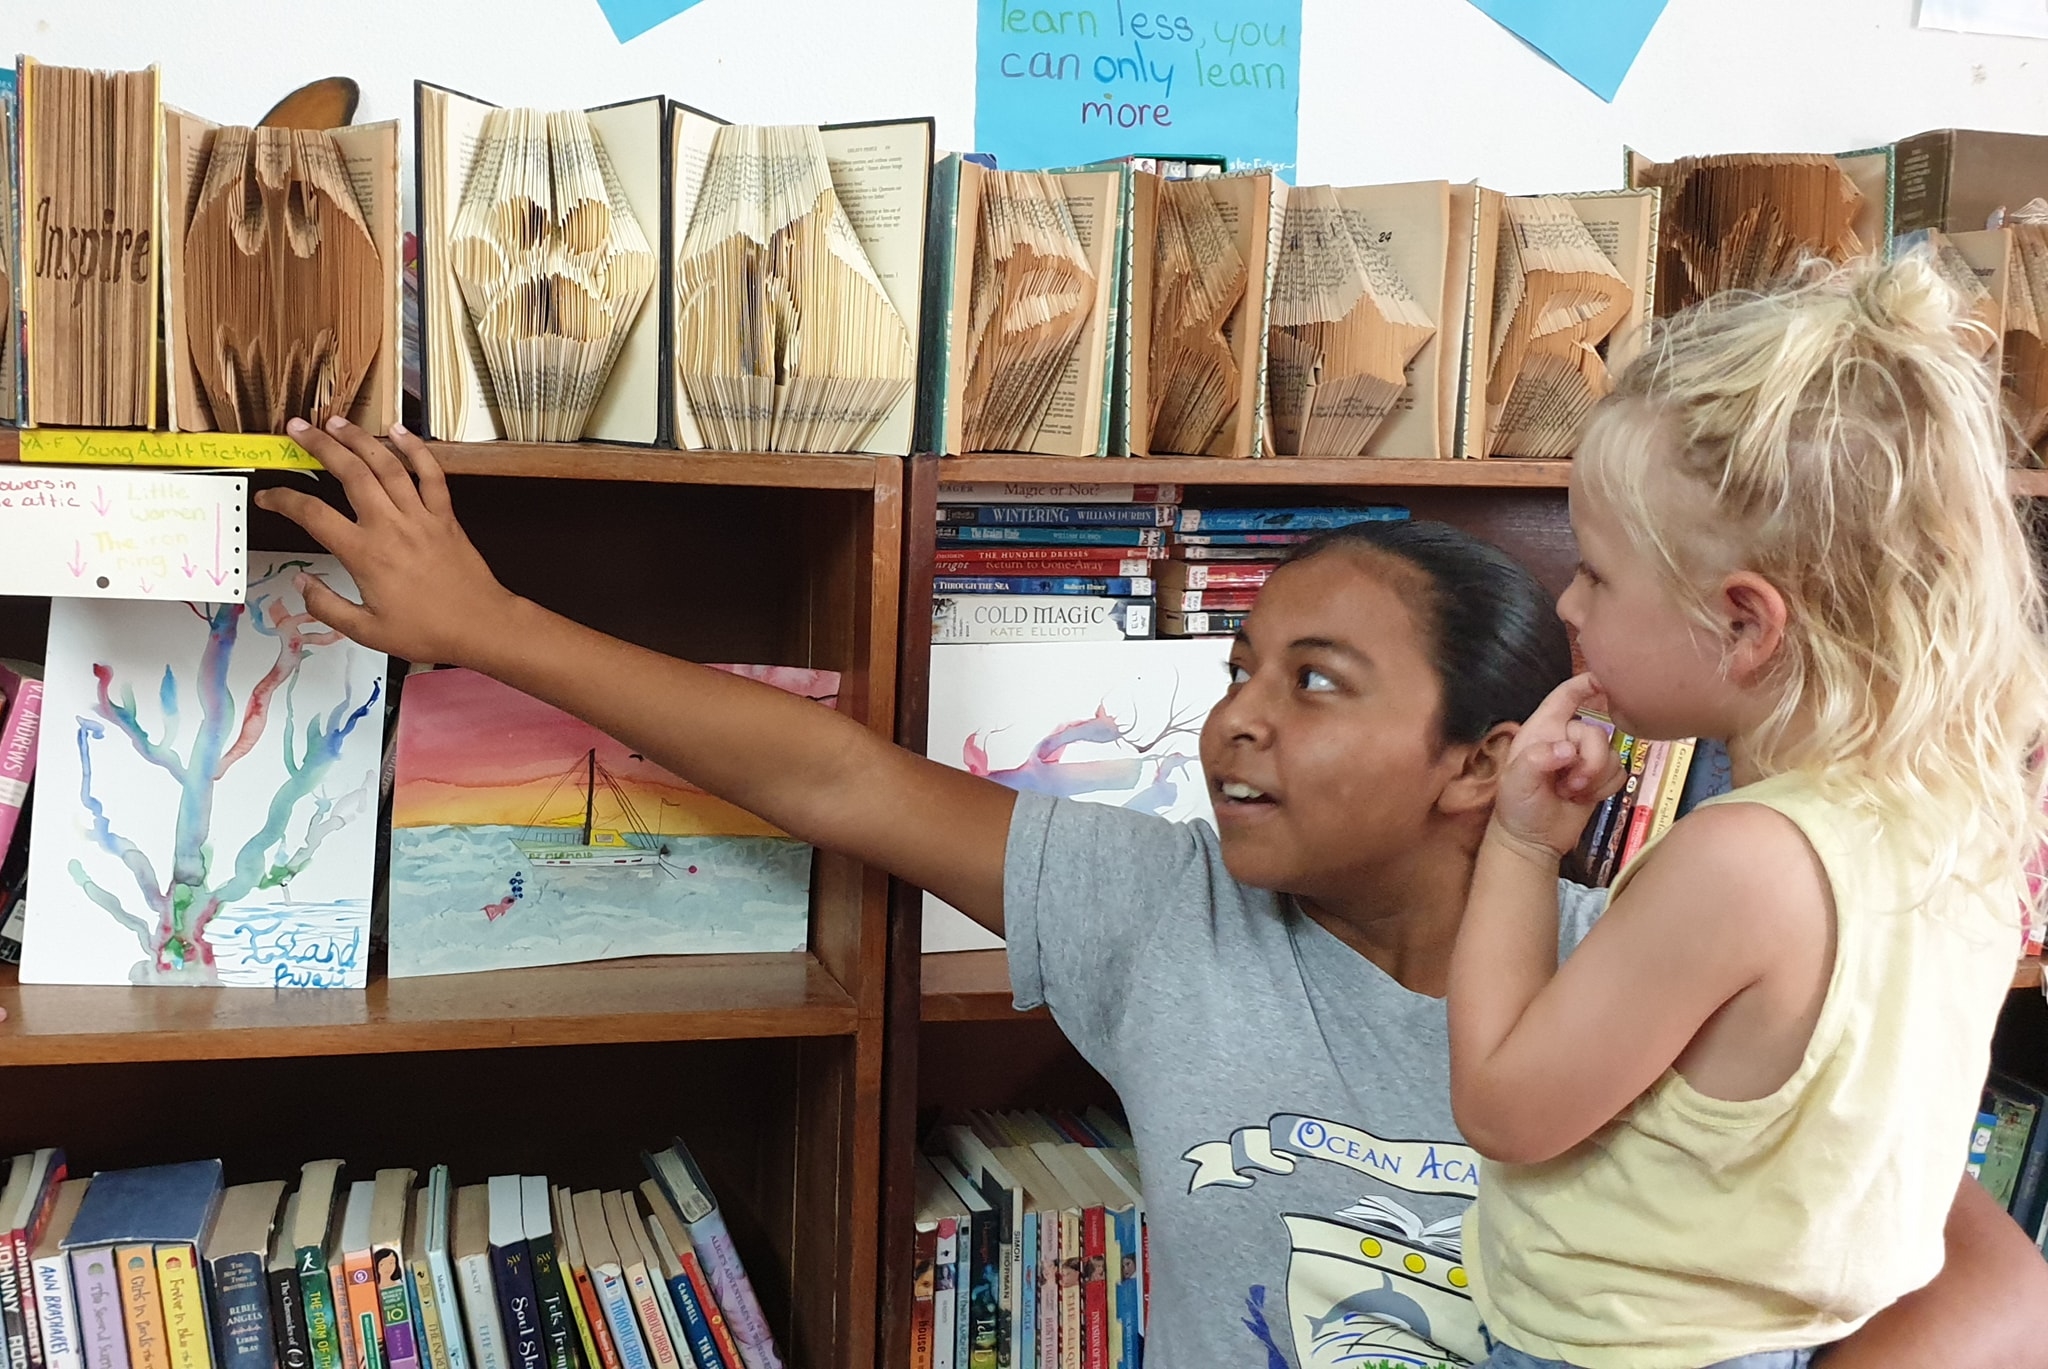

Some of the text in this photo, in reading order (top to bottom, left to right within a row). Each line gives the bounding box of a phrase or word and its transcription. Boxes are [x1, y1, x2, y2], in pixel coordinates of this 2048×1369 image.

[1000, 0, 1098, 37] learn
[1213, 20, 1287, 56] you
[1001, 40, 1286, 98] can only learn
[1082, 99, 1172, 128] more
[35, 196, 149, 308] Inspire
[76, 436, 133, 463] Young
[138, 439, 194, 459] Adult
[200, 442, 272, 460] Fiction
[59, 480, 77, 490] in
[128, 483, 190, 500] Little
[1004, 482, 1040, 498] Magic
[1051, 484, 1064, 496] or
[21, 493, 80, 508] attic
[992, 507, 1152, 523] WINTERING WILLIAM DURBIN
[1001, 550, 1047, 559] HUNDRED
[1051, 550, 1089, 558] DRESSES
[940, 582, 977, 591] THROUGH
[978, 583, 993, 591] THE
[994, 582, 1010, 591] SEA
[974, 605, 1028, 624] COLD
[990, 626, 1088, 637] KATE ELLIOTT
[3, 709, 40, 773] ANDREWS
[1632, 740, 1649, 772] UNKE
[1671, 747, 1687, 785] GEORGE
[1297, 1121, 1402, 1174] OCEAN
[15, 1238, 42, 1365] JOHNNY ROCKET
[130, 1275, 151, 1303] Girls
[310, 1291, 322, 1310] THE
[724, 1267, 750, 1320] ADVENTURES
[39, 1265, 70, 1354] ANN BRASHARES
[229, 1303, 258, 1316] REBEL
[280, 1280, 291, 1296] The
[288, 1337, 299, 1346] of
[511, 1296, 535, 1335] Soul
[1066, 1291, 1076, 1319] THE
[227, 1312, 263, 1327] ANGELS
[313, 1312, 327, 1339] FORM
[641, 1296, 673, 1364] THOROUGHBRED
[678, 1282, 699, 1325] CAMPBELL
[698, 1335, 714, 1362] THE
[976, 1319, 996, 1345] Ida
[1091, 1311, 1101, 1346] INVASION
[317, 1340, 331, 1355] OF
